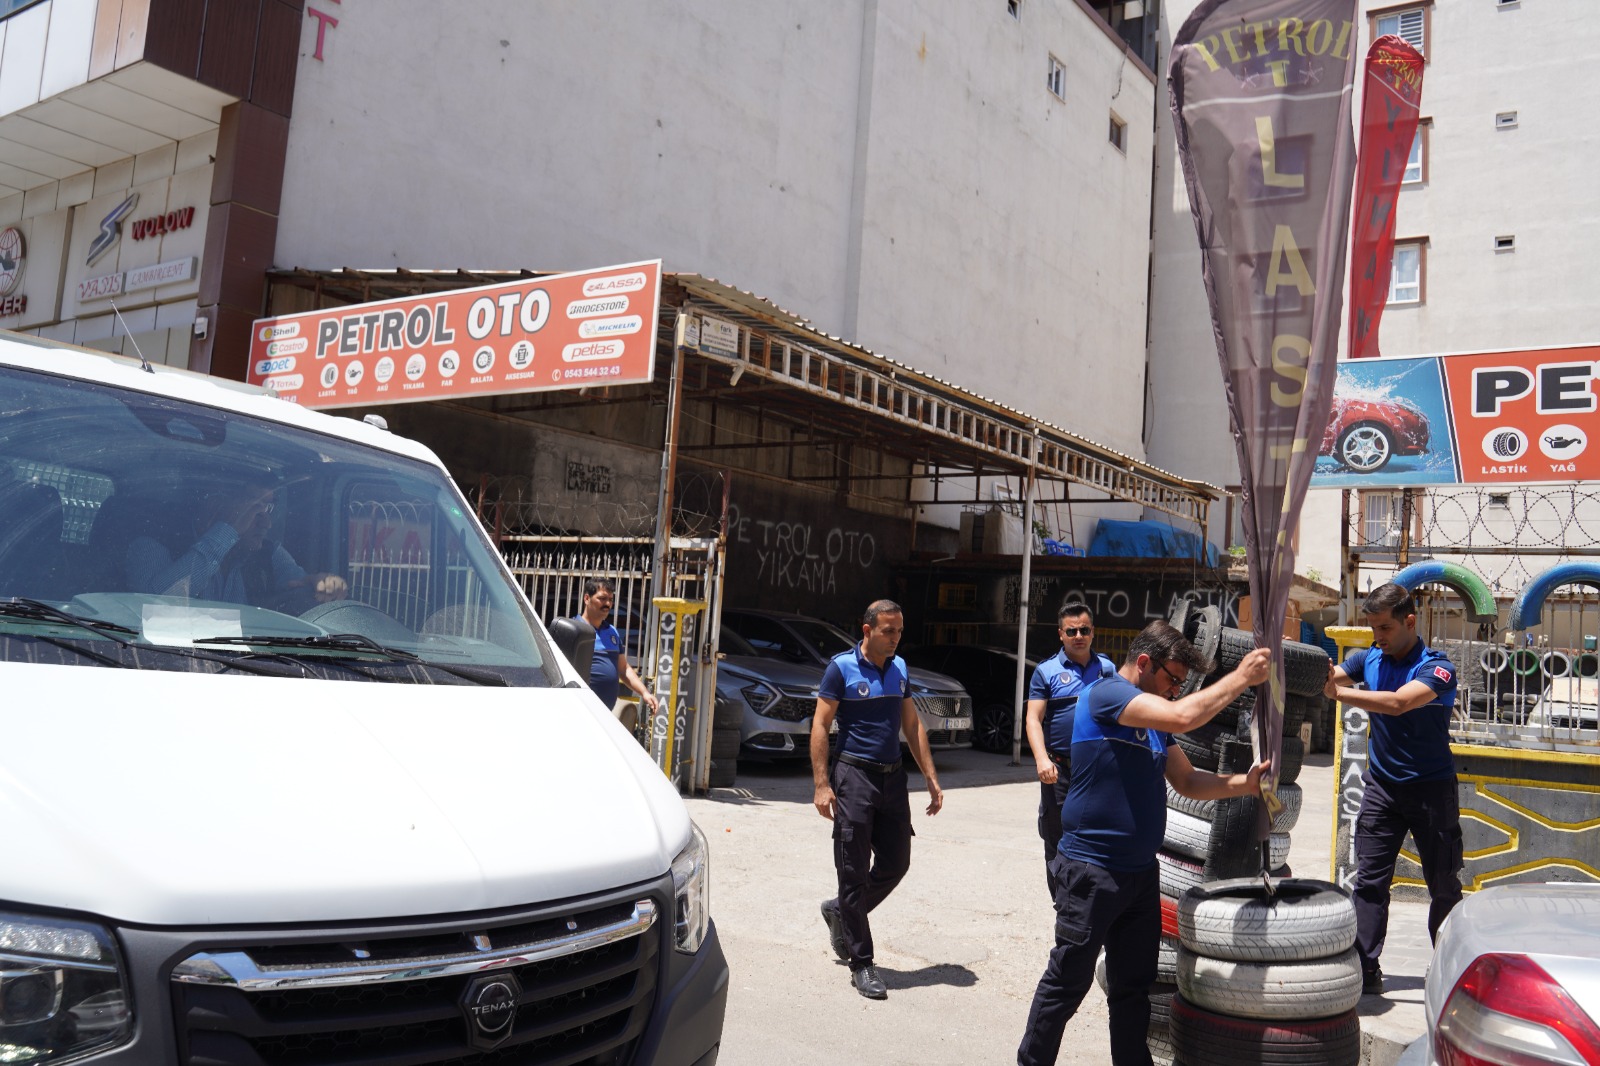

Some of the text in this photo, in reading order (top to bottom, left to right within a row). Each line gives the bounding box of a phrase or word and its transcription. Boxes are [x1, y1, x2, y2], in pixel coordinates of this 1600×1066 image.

[1193, 17, 1353, 72] PETROL
[596, 277, 643, 291] LASSA
[569, 300, 626, 315] BRIDGESTONE
[315, 287, 551, 359] PETROL OTO
[597, 322, 636, 332] MICHELIN
[273, 327, 295, 337] Shell
[571, 343, 615, 360] petlas
[564, 366, 620, 379] 0543 544 32 43
[403, 381, 425, 391] YIKAMA
[441, 379, 453, 387] FAR
[470, 375, 494, 384] BALATA
[505, 371, 535, 381] AKSESUAR
[1471, 361, 1600, 417] PE
[1482, 461, 1576, 475] LASTİK YAĞ
[826, 528, 875, 568] OTO
[757, 548, 836, 595] YIKAMA
[471, 999, 515, 1015] TENAX
